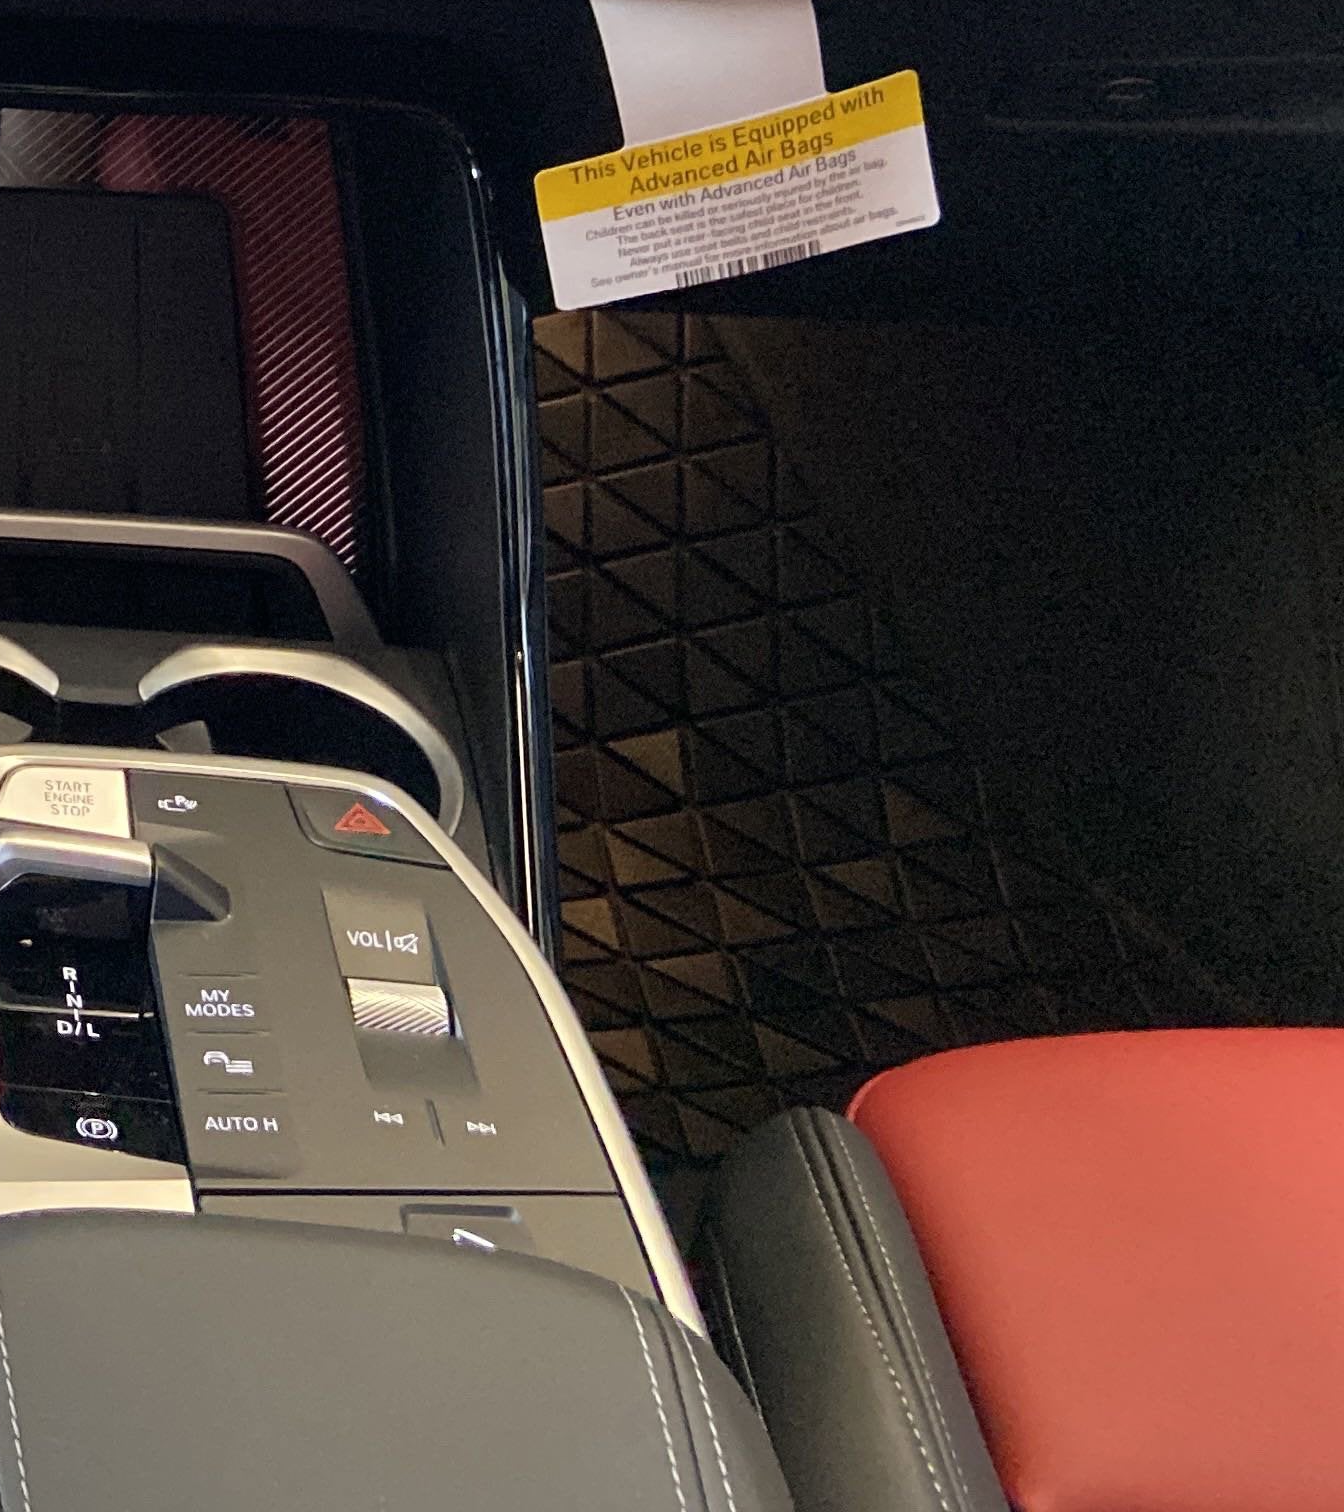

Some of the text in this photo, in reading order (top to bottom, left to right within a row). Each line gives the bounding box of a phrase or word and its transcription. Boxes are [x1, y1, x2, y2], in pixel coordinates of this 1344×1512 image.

[569, 87, 884, 185] This Vehicle is Equipped with
[630, 131, 833, 194] Advanced Air Bags
[613, 150, 857, 221] Even with Advanced Air Bags
[585, 223, 633, 241] Children
[635, 219, 656, 229] can
[658, 215, 672, 225] be
[675, 207, 705, 221] killed
[707, 206, 718, 215] or
[721, 193, 772, 211] seriously
[774, 181, 812, 198] injured
[814, 178, 826, 188] by
[829, 171, 846, 182] the
[616, 235, 639, 245] The
[641, 227, 667, 241] back
[670, 222, 694, 234] seat
[709, 216, 727, 225] the
[730, 207, 763, 222] safest
[766, 199, 797, 214] place
[799, 193, 813, 204] for
[618, 244, 650, 259] Never
[748, 216, 775, 229] child
[777, 209, 800, 222] seat
[630, 252, 669, 267] Always
[43, 779, 92, 793] START
[43, 791, 95, 806] ENGINE
[50, 803, 91, 817] STOP
[346, 930, 385, 949] VOL
[62, 966, 78, 981] R
[65, 993, 83, 1009] N
[200, 989, 230, 1002] MY
[184, 1002, 255, 1018] MODES
[204, 1116, 279, 1132] AUTO H
